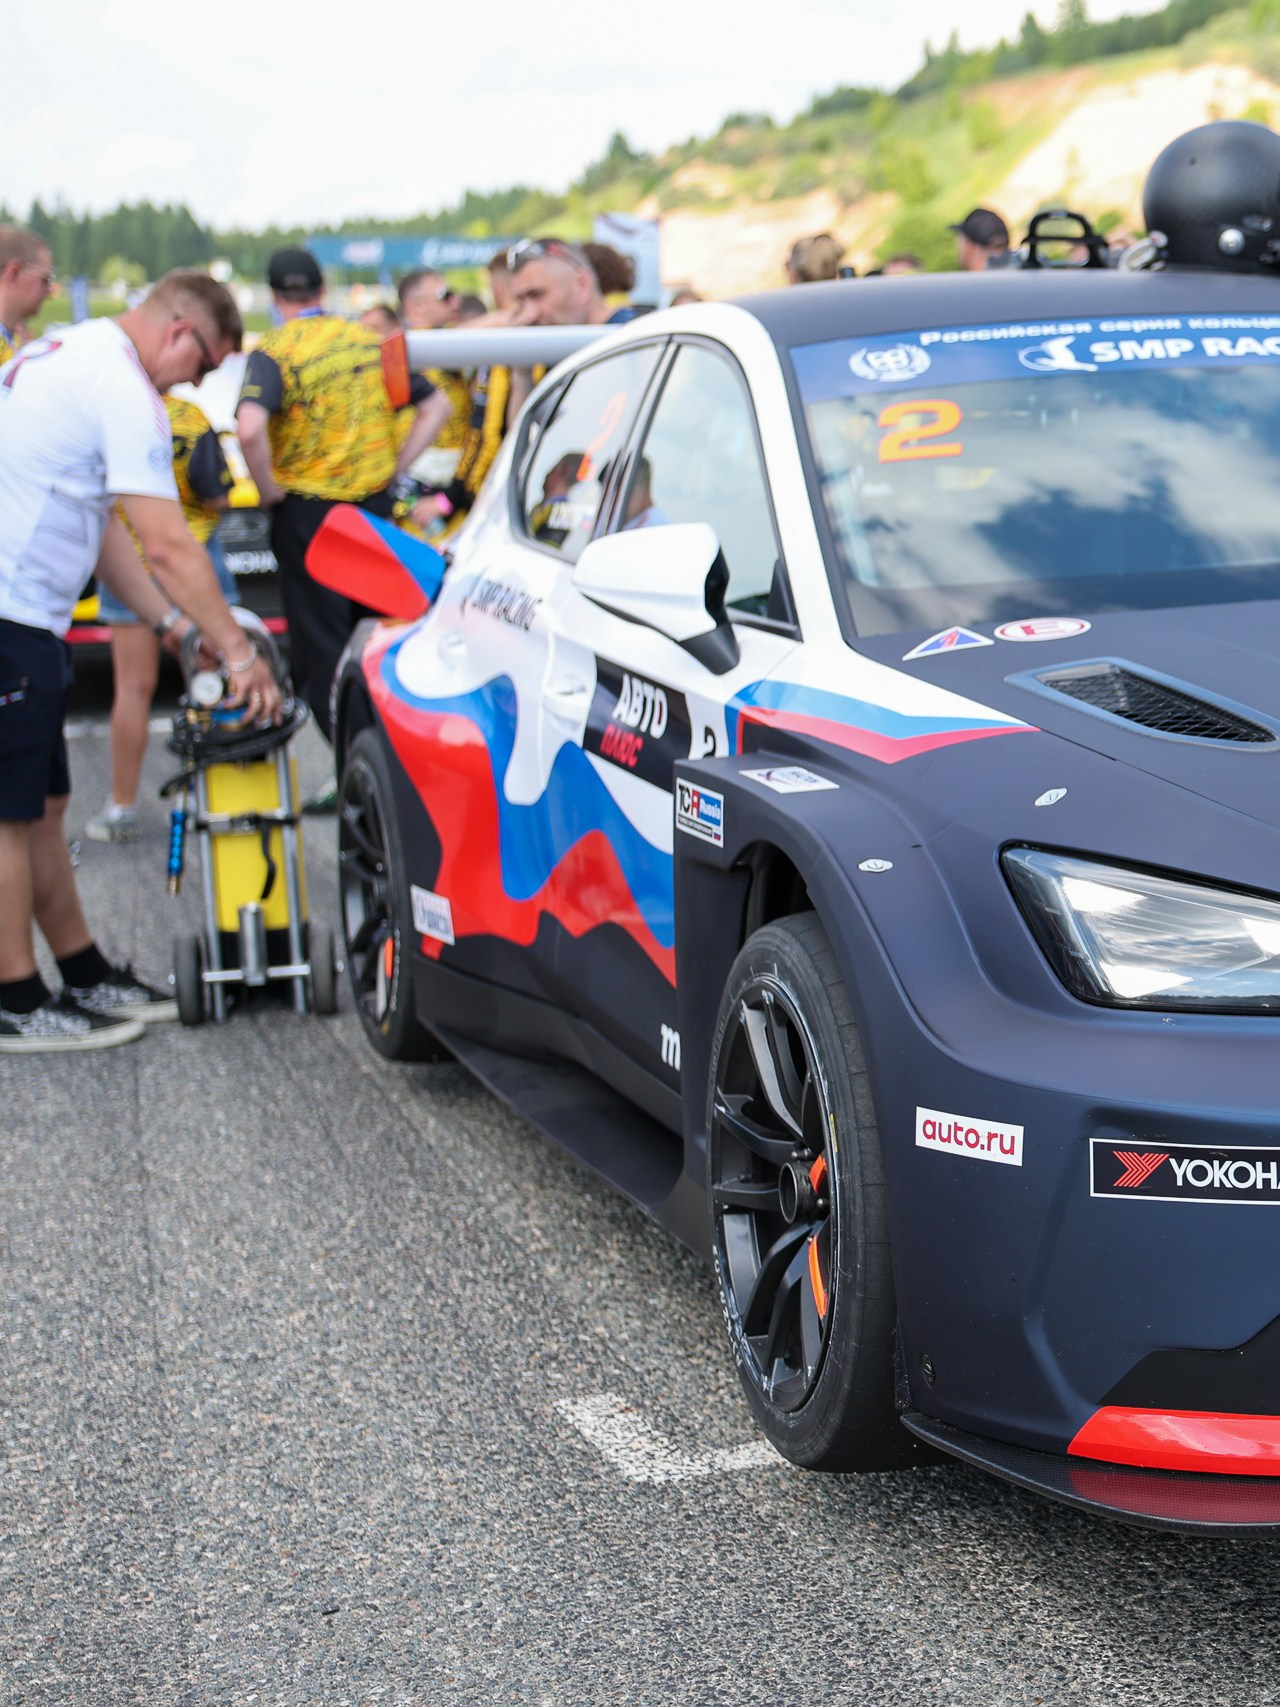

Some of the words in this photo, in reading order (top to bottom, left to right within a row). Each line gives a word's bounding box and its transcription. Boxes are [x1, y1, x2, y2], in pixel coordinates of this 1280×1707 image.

[919, 322, 1092, 346] Российская
[1099, 317, 1182, 333] серия
[1089, 337, 1195, 363] SMP
[877, 399, 963, 463] 2
[612, 673, 668, 740] АВТО
[700, 797, 721, 821] Russia
[922, 1118, 1016, 1156] auto.ru
